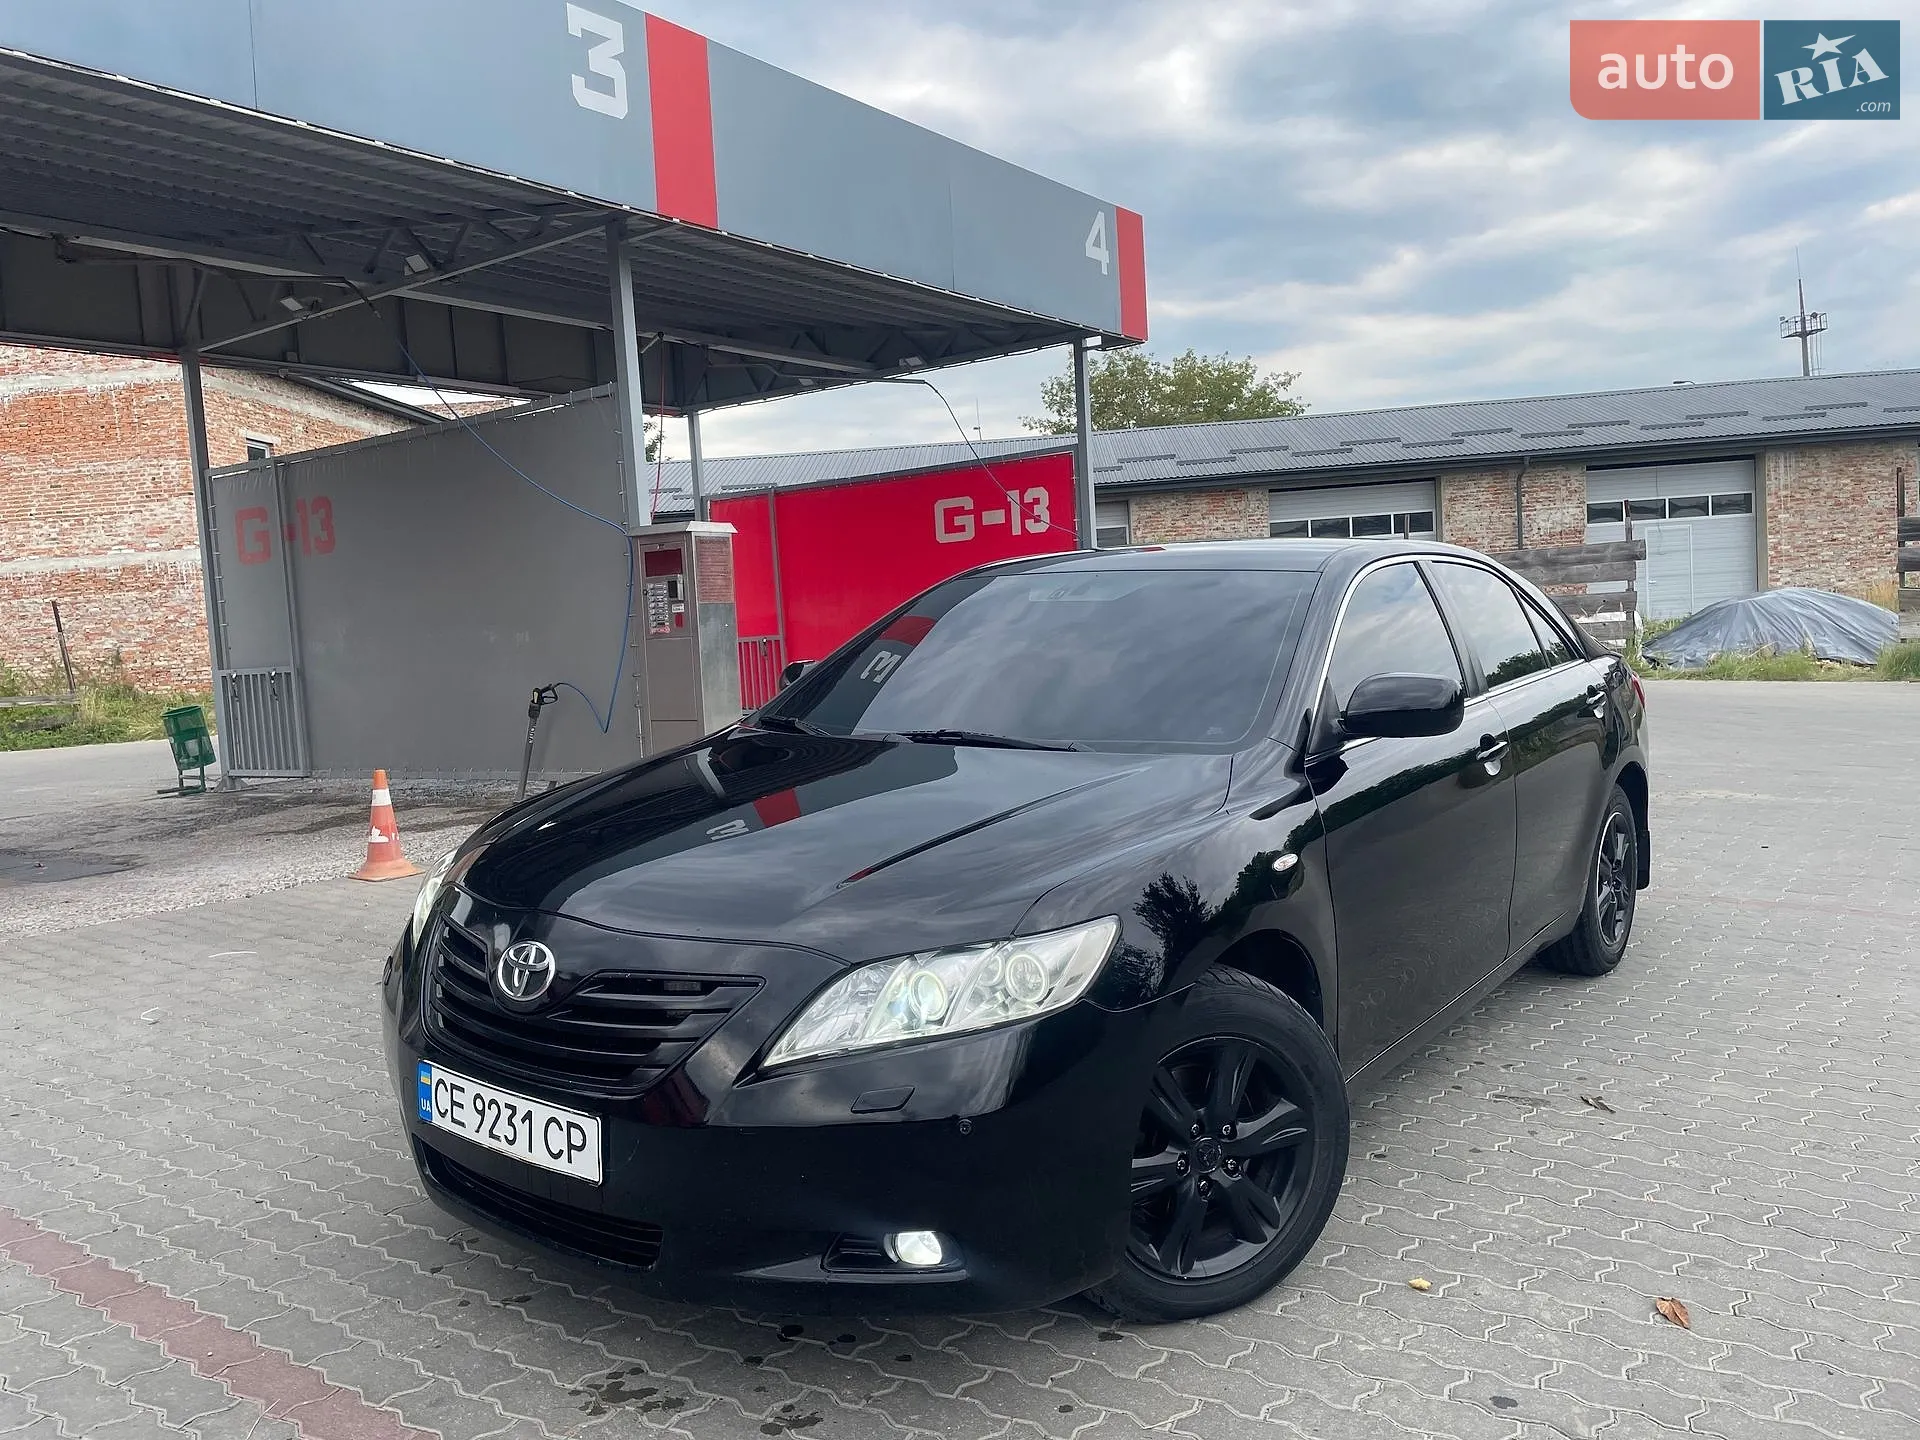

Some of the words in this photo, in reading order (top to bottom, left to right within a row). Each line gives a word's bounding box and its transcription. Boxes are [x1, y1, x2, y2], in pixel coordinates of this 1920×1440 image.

[566, 2, 628, 119] 3
[1085, 210, 1110, 275] 4
[234, 496, 336, 565] G-13
[933, 486, 1050, 544] G-13
[421, 1098, 431, 1113] UA
[434, 1078, 467, 1129] CE
[472, 1092, 534, 1154] 9231
[543, 1116, 587, 1164] CP
